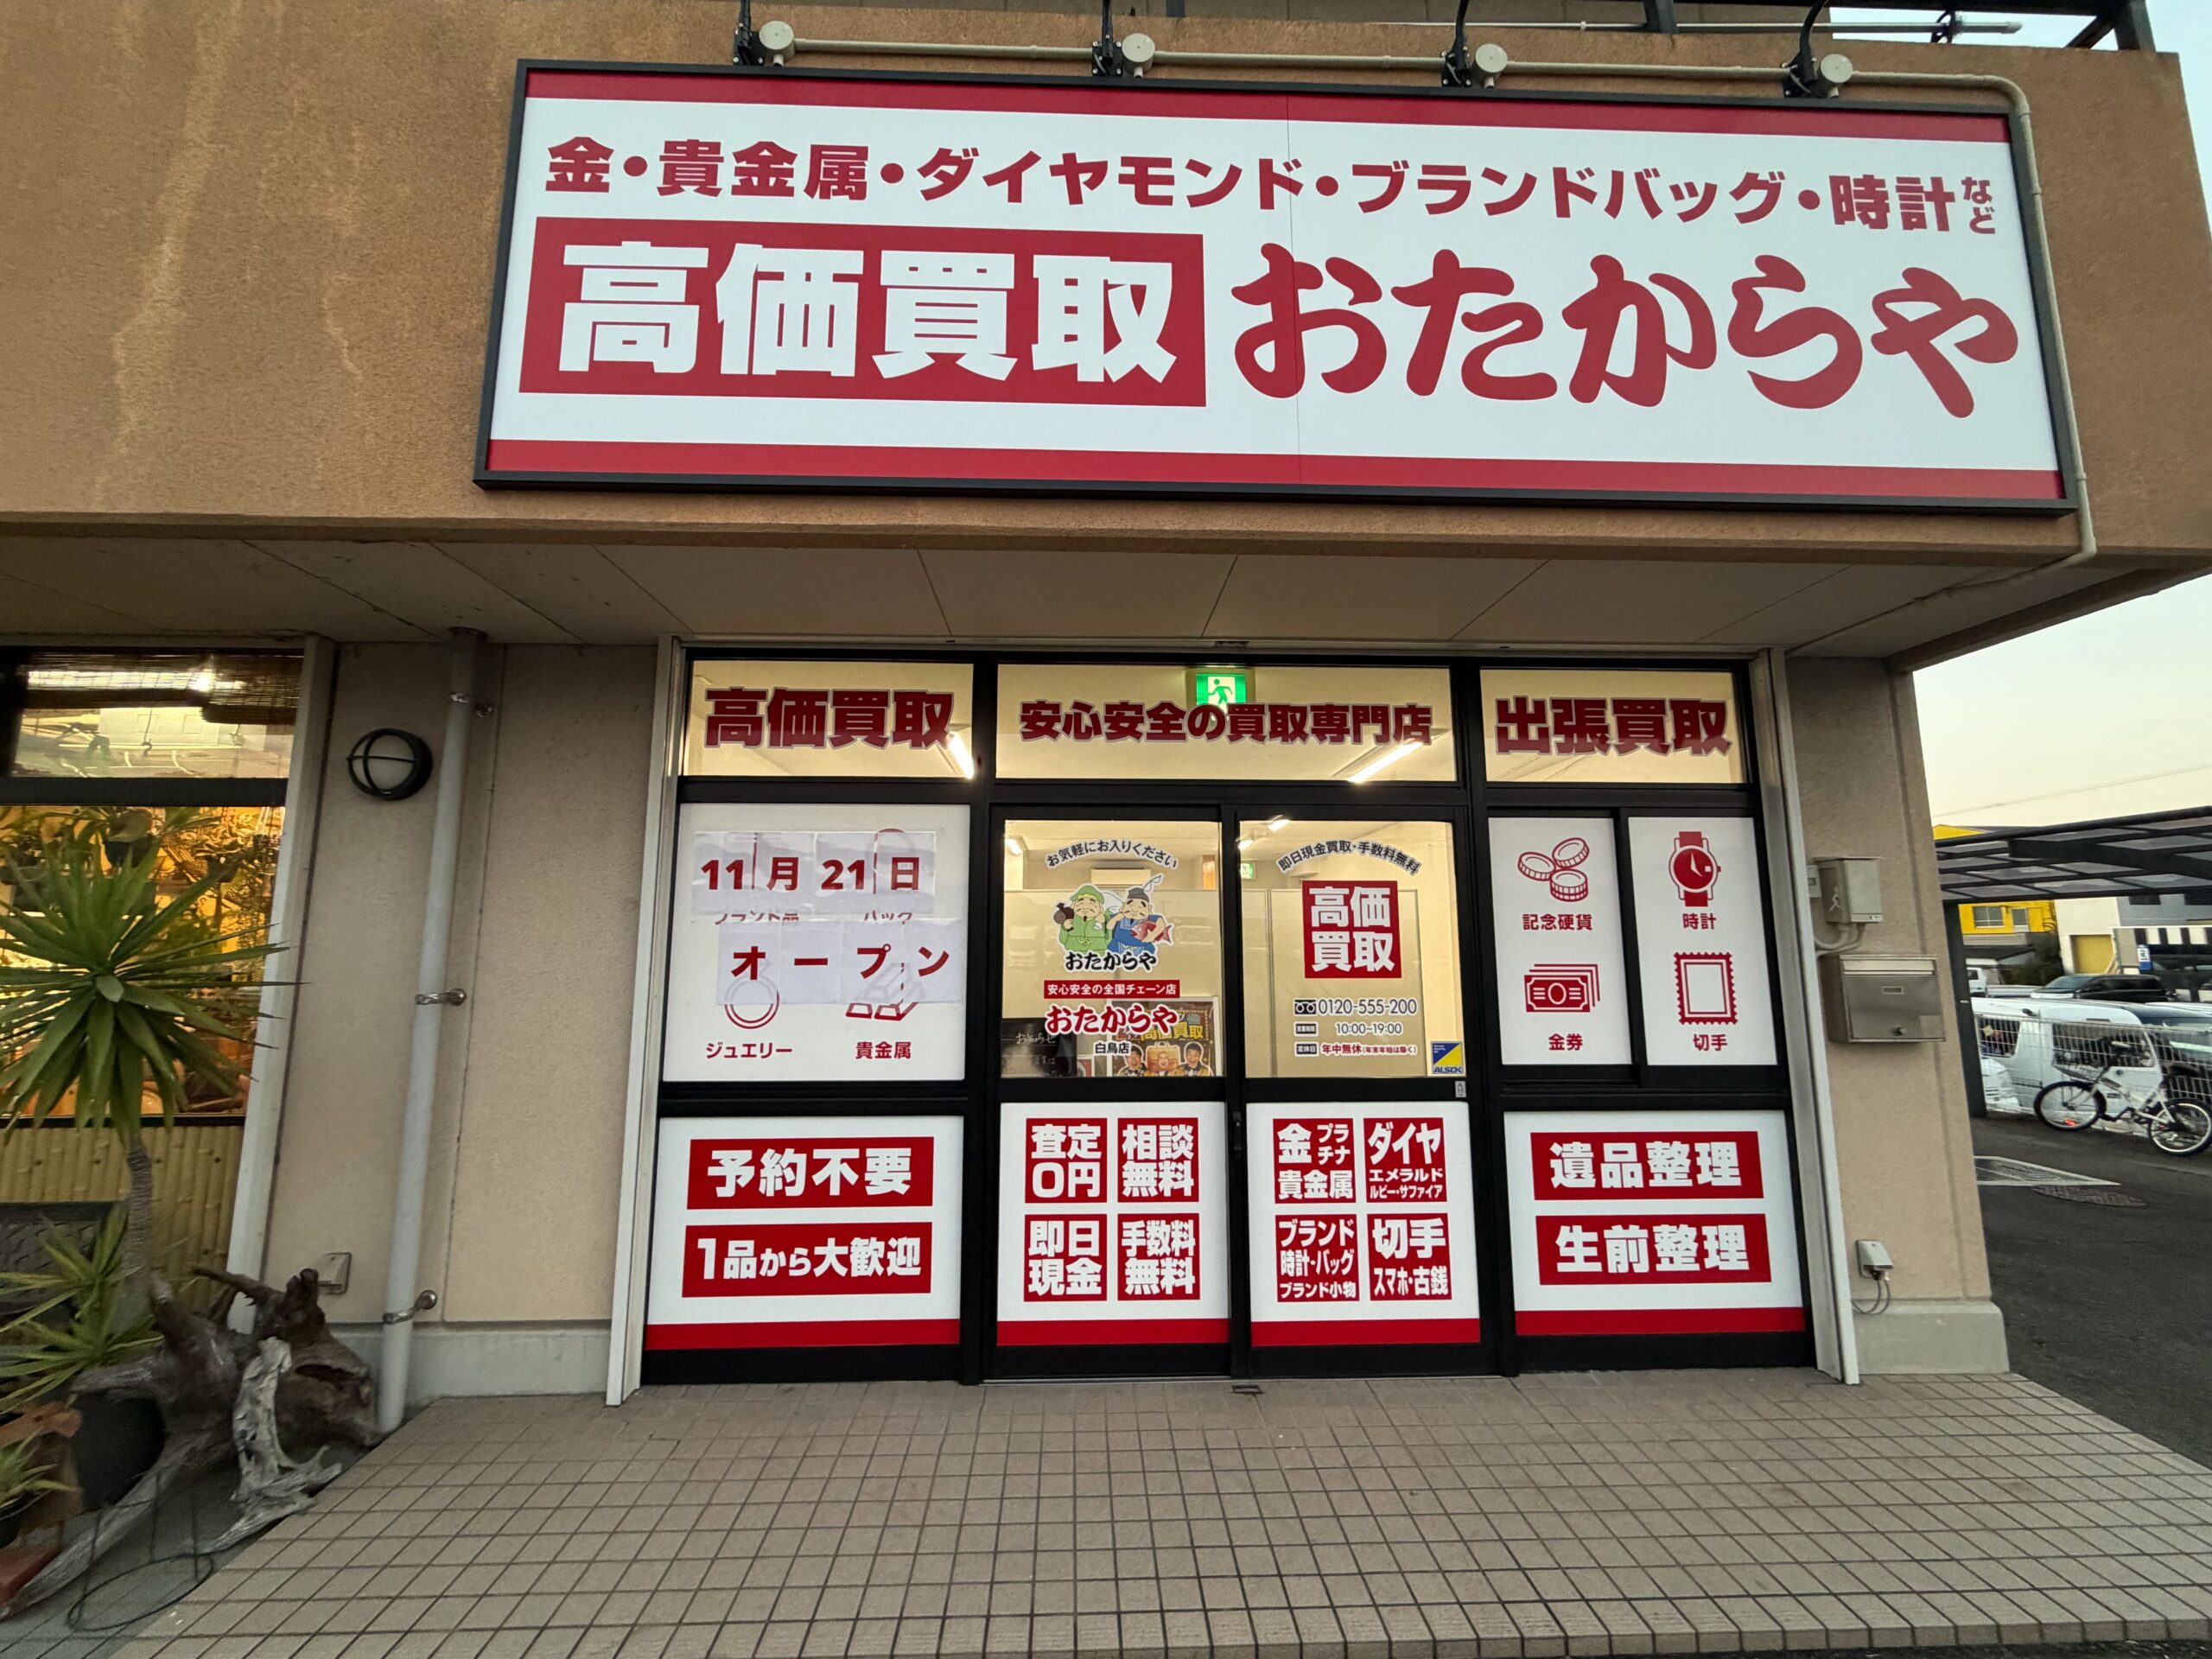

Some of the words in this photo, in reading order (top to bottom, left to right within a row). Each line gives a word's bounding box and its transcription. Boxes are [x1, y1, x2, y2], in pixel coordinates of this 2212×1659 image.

[545, 136, 1955, 232] 金・貴金属・ダイヤモンド・ブランドバッグ・時計
[558, 240, 1176, 383] 高価買取
[1231, 242, 2018, 418] おたからや
[705, 687, 955, 749] 高価買取
[1020, 700, 1432, 745] 安心安全の買取専門店
[1496, 696, 1732, 755] 出張買取
[1047, 840, 1177, 868] お気軽にお入りください
[1279, 841, 1421, 873] 即日現金買取・手数料無料
[701, 856, 799, 891] 11月
[821, 856, 920, 891] 21日
[1309, 887, 1391, 927] 高価
[1522, 914, 1592, 931] 記念硬貨
[1683, 913, 1717, 930] 時計
[731, 944, 950, 981] オープン
[1065, 951, 1157, 970] おたからや
[1312, 931, 1395, 972] 買取
[1047, 983, 1177, 995] 安心安全の全国チェーン店
[1319, 999, 1417, 1014] 0120-555-200
[1046, 1005, 1178, 1033] おたからや
[706, 1042, 792, 1059] ジュエリー
[855, 1041, 912, 1059] 貴金属
[1548, 1033, 1584, 1051] 金券
[1693, 1033, 1728, 1052] 切手
[1031, 1124, 1102, 1160] 査定
[1122, 1124, 1194, 1160] 相談
[1277, 1123, 1312, 1164] 金
[1367, 1122, 1441, 1166] ダイヤ
[708, 1147, 912, 1198] 予約不要
[1122, 1160, 1194, 1197] 無料
[1369, 1168, 1443, 1182] エメラルド
[1549, 1141, 1743, 1189] 遺品整理
[1278, 1170, 1353, 1199] 貴金属
[1370, 1185, 1443, 1199] ルビー・サファイア
[1028, 1220, 1100, 1257] 即日
[1122, 1219, 1196, 1257] 手数料
[1279, 1218, 1355, 1247] ブランド
[1372, 1217, 1446, 1259] 切手
[1555, 1224, 1751, 1273] 生前整理
[697, 1236, 922, 1280] 1品から大歓迎
[1124, 1257, 1196, 1294] 無料
[1280, 1249, 1354, 1277] 時計・バッグ
[1028, 1257, 1103, 1296] 現金
[1280, 1281, 1357, 1299] ブランド小物
